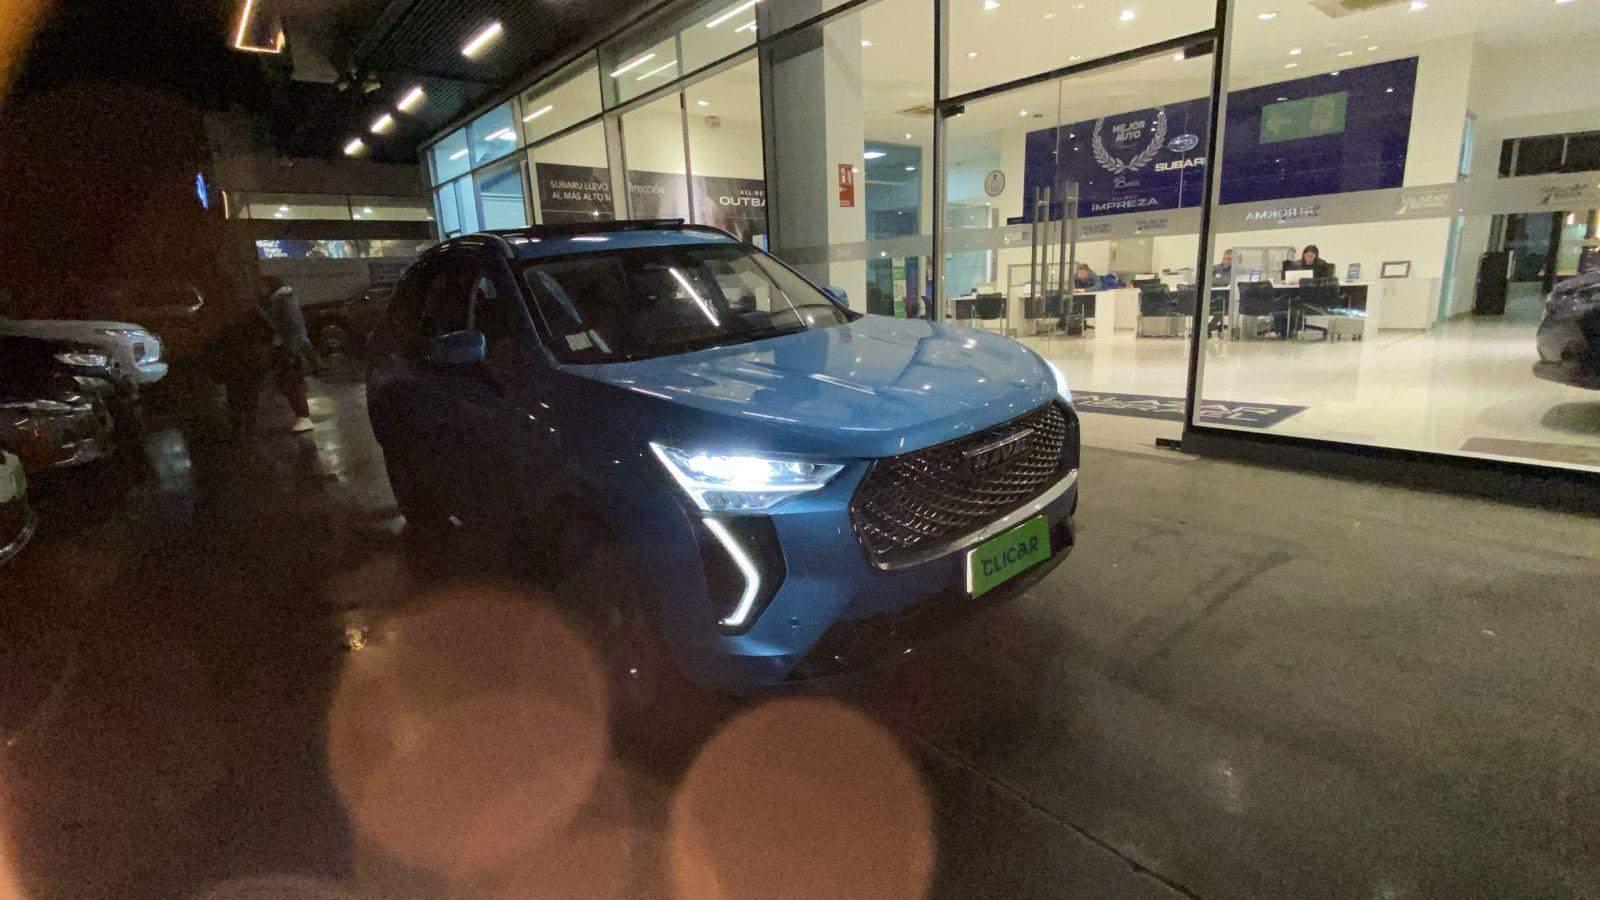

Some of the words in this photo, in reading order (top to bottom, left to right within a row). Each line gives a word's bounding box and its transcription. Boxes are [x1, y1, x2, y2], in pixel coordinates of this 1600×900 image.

[1112, 120, 1146, 134] MEJOR
[1115, 130, 1141, 142] AUTO
[550, 179, 583, 190] SUBARU
[584, 182, 609, 191] LLEVO
[551, 191, 562, 200] AL
[583, 193, 604, 202] ALTO
